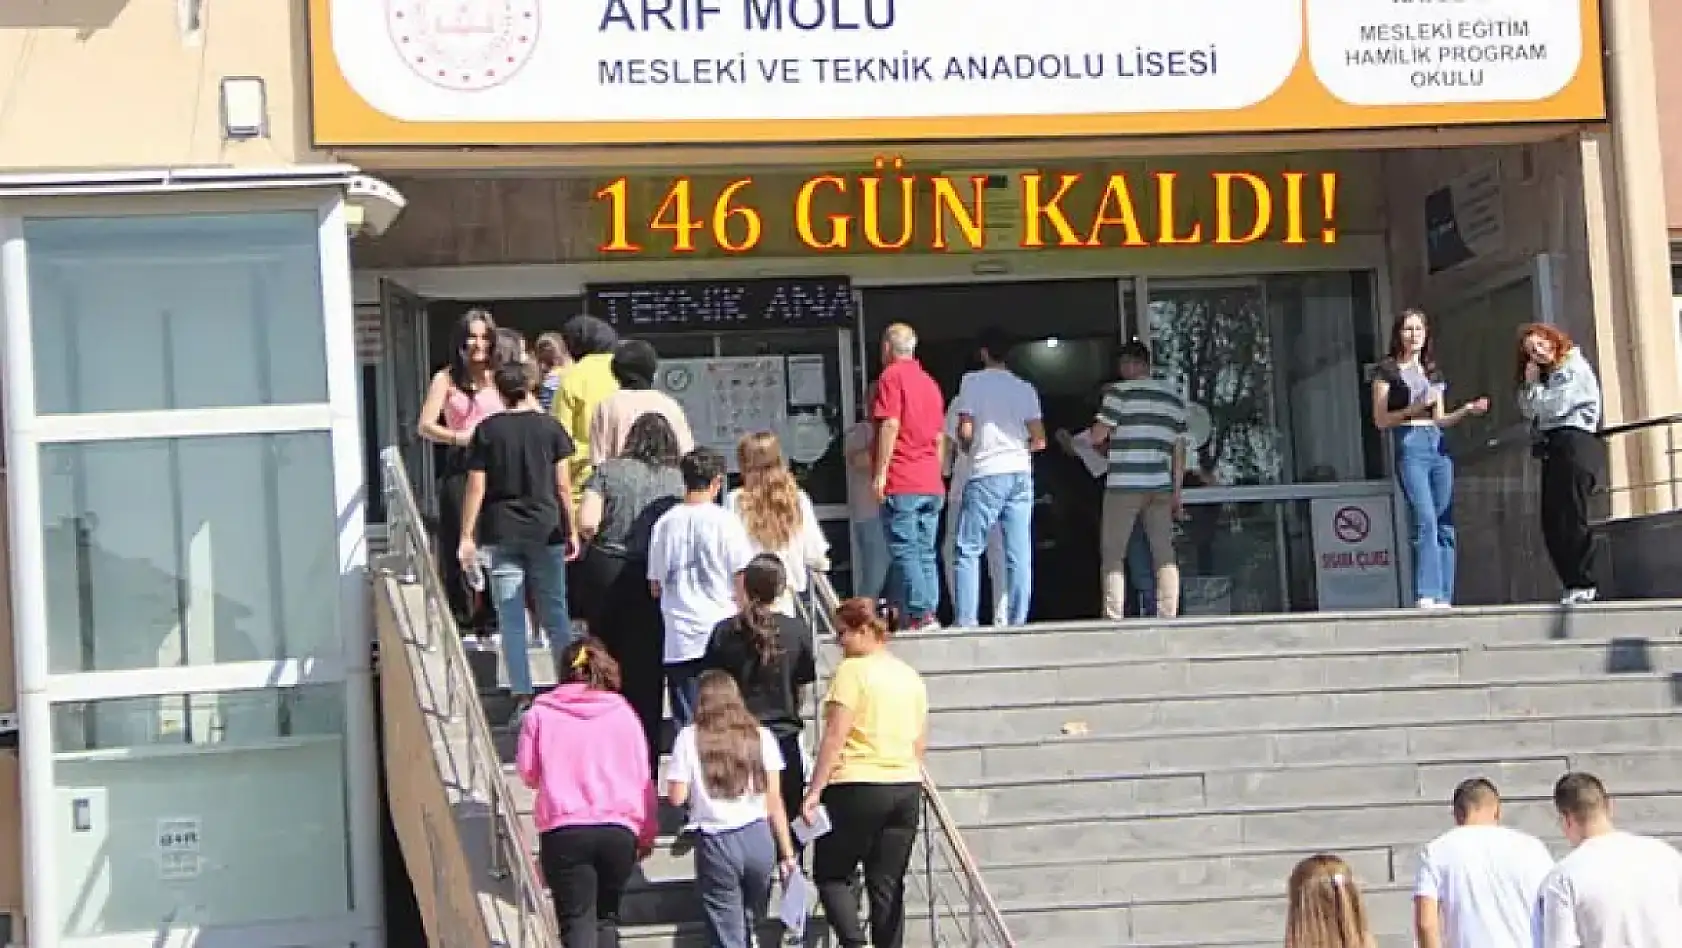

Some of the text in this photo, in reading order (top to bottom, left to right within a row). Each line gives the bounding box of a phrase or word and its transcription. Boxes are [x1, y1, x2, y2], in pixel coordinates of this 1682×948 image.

[743, 0, 895, 30] MOLU
[598, 44, 1217, 84] MESLEKİ VE TEKNİK ANADOLU LİSESİ
[1438, 43, 1548, 63] PROGRAM
[1410, 68, 1485, 88] OKULU
